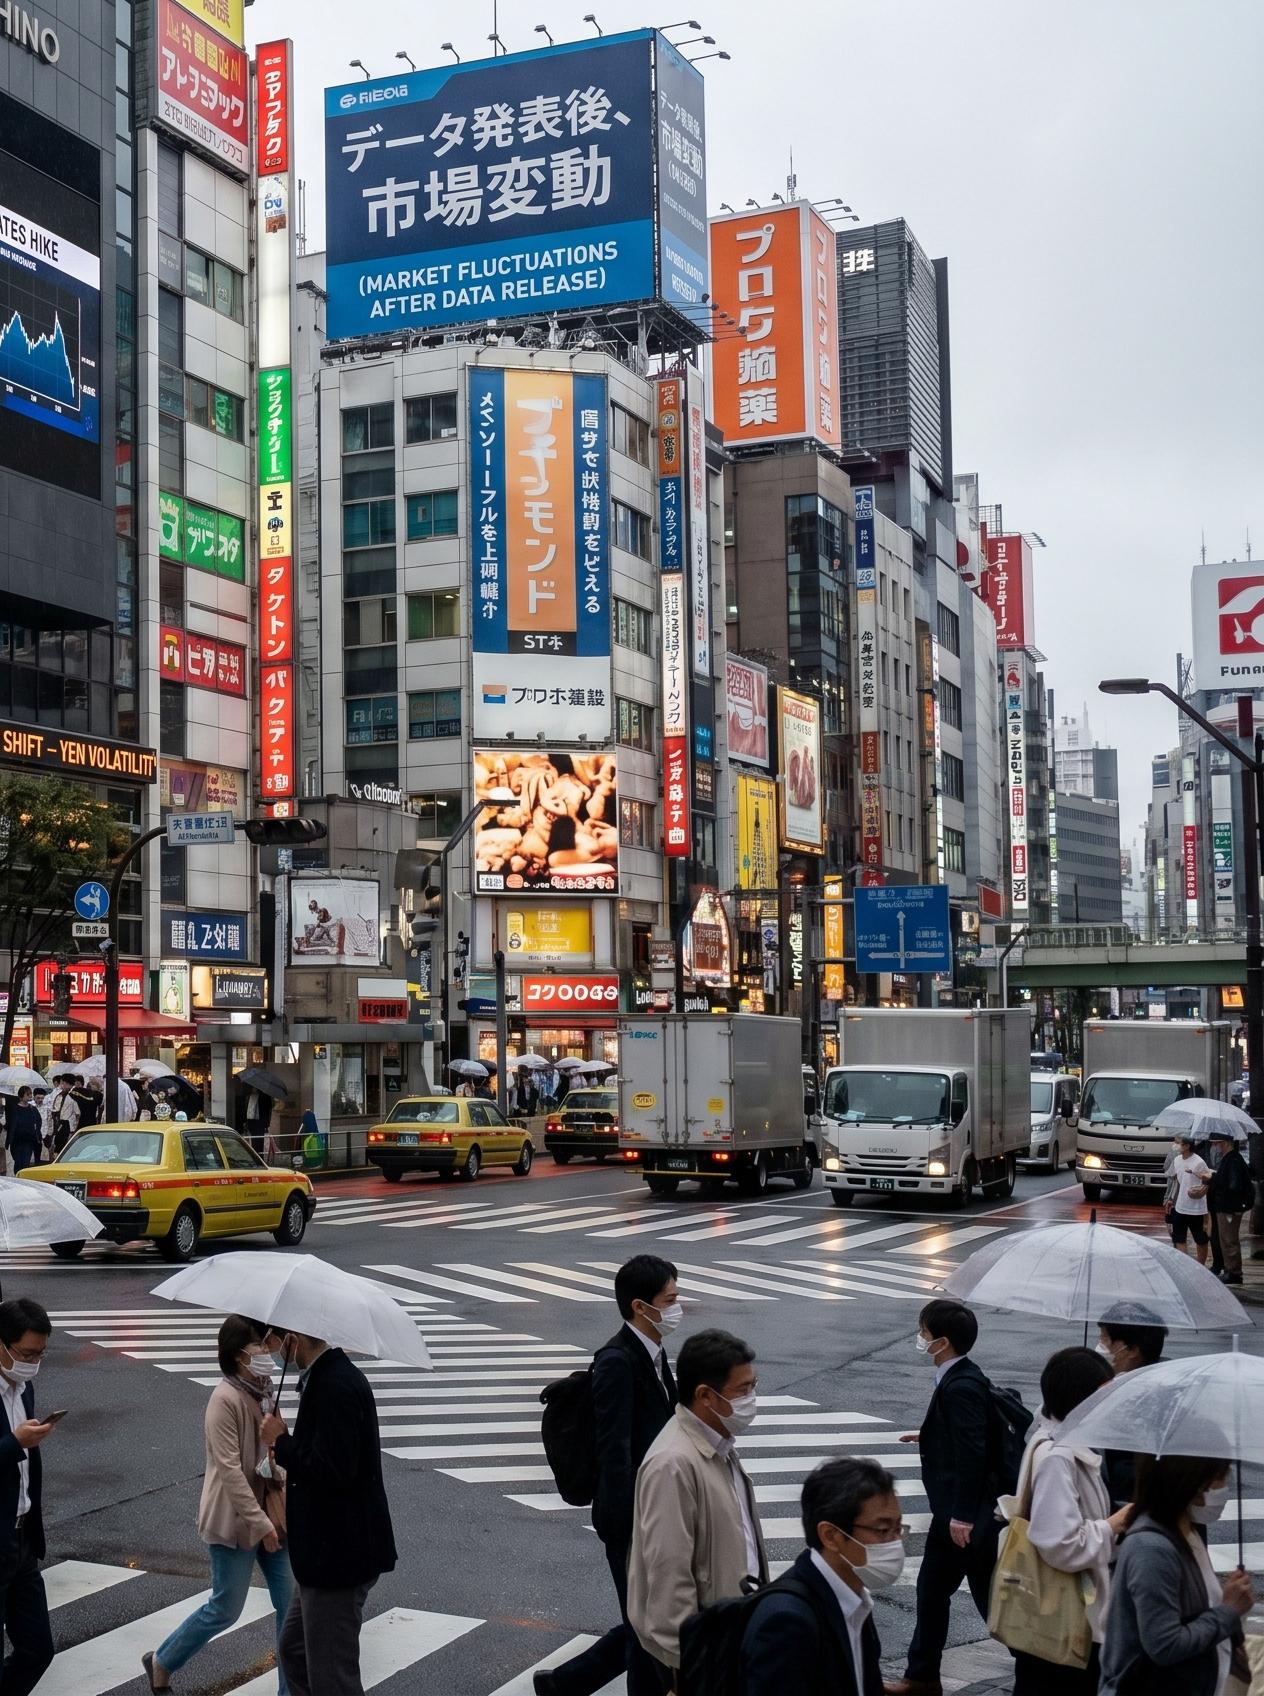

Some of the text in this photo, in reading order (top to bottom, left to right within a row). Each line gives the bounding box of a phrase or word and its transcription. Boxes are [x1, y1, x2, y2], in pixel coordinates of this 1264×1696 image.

[341, 85, 632, 173] データ発表後、
[362, 144, 611, 238] 市場変動
[30, 229, 59, 262] HIKE
[359, 240, 618, 297] (MARKET FLUCTUATIONS
[369, 266, 606, 319] AFTER DATA RELEASE)
[3, 730, 44, 758] SHIFT
[59, 739, 86, 766] YEN
